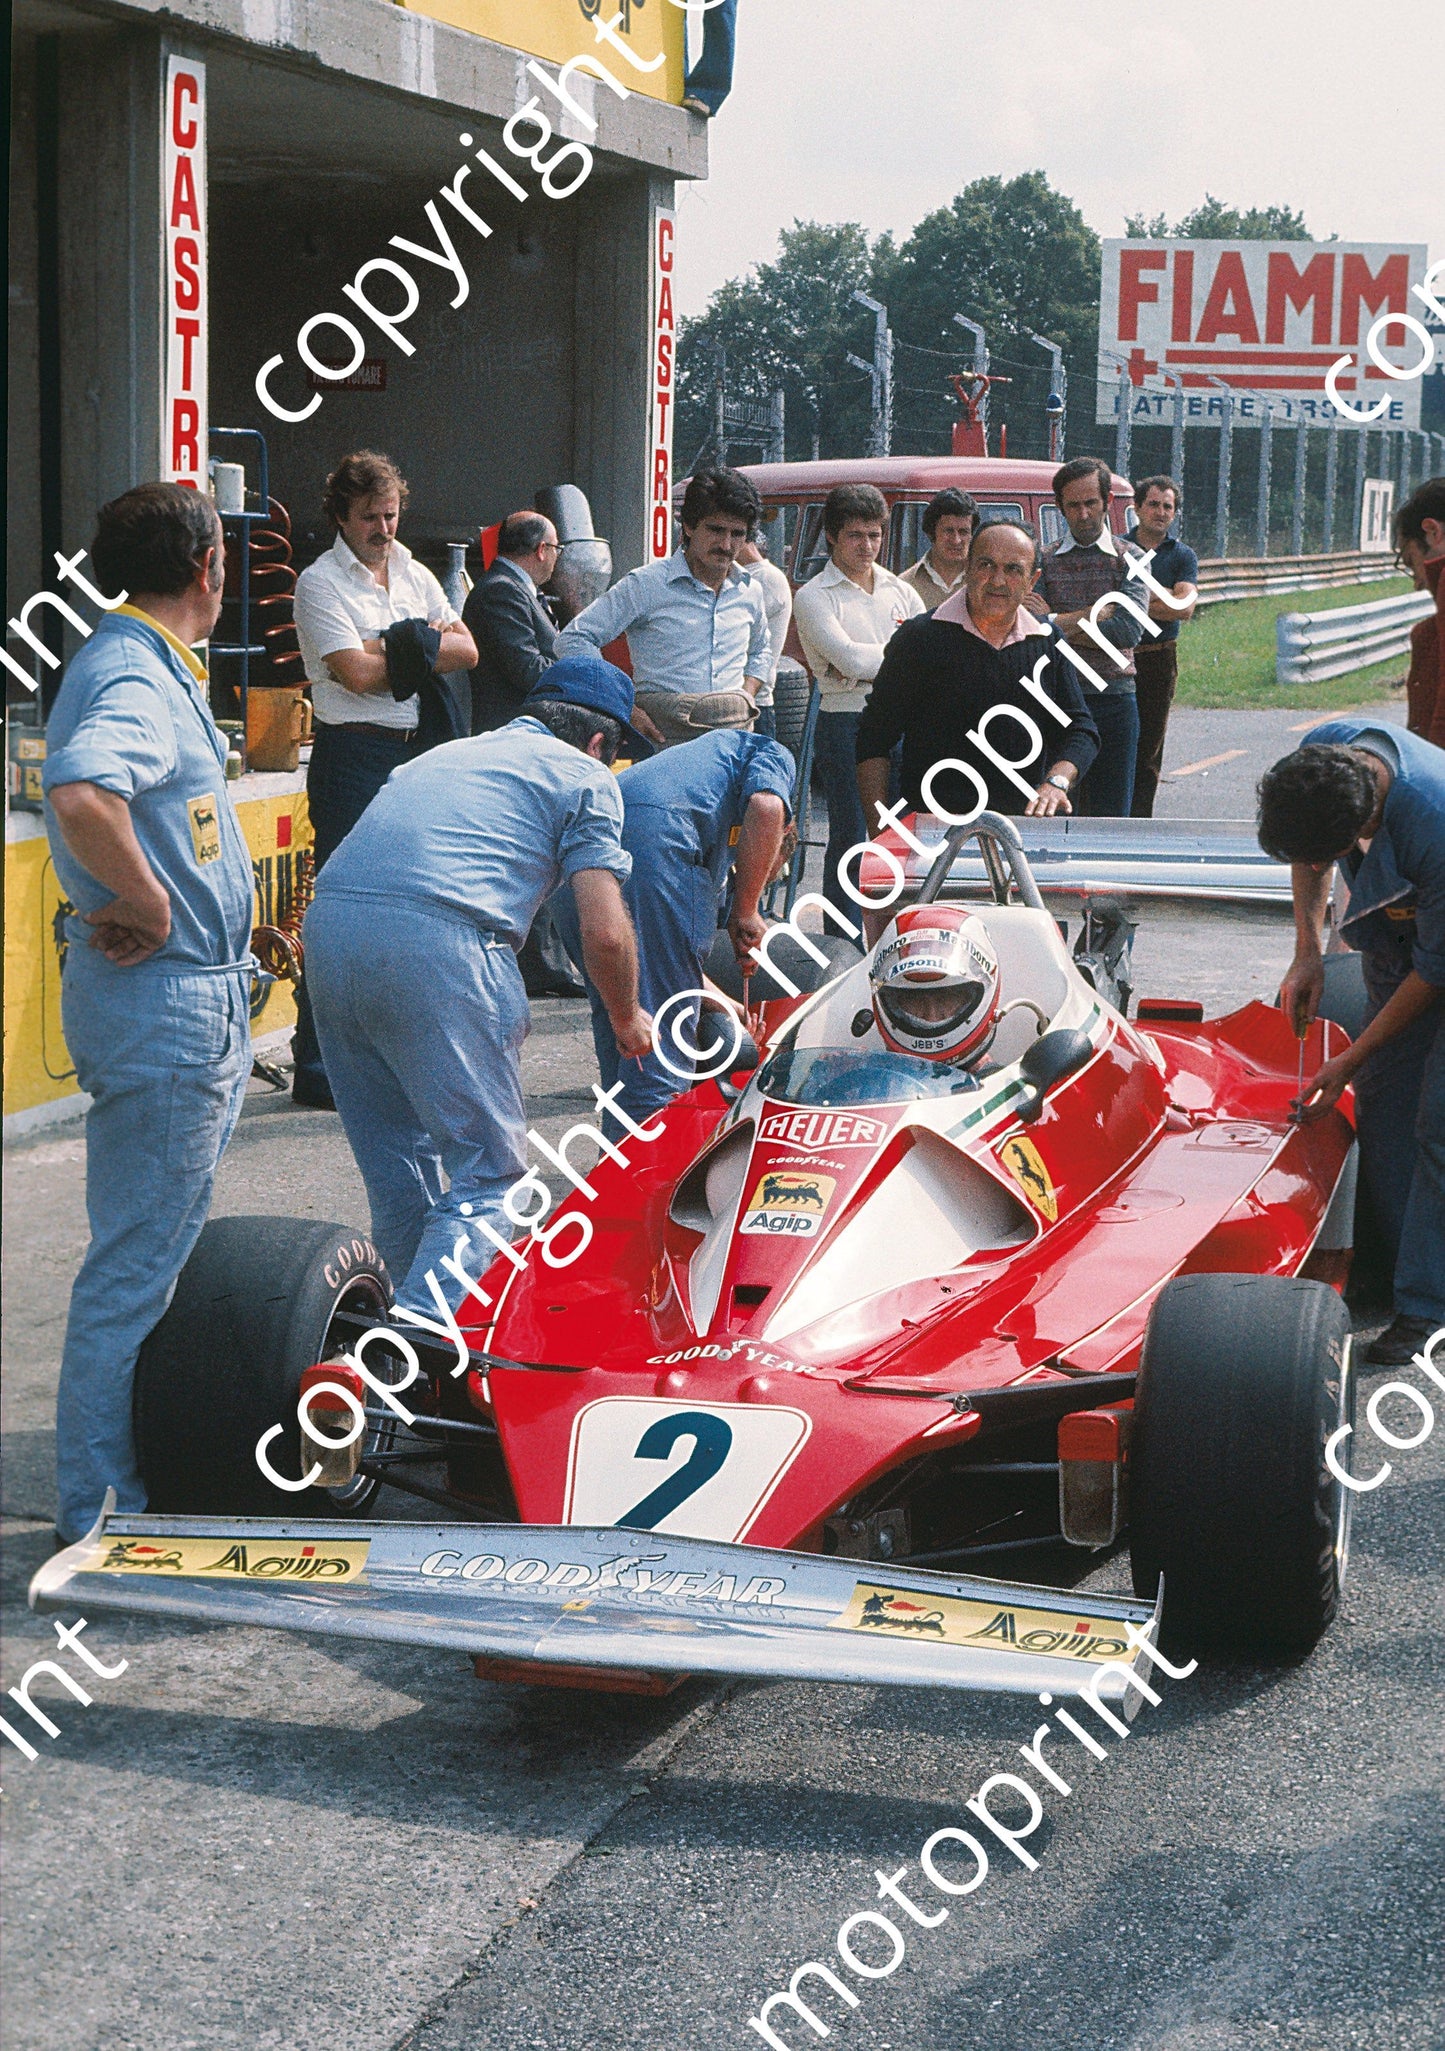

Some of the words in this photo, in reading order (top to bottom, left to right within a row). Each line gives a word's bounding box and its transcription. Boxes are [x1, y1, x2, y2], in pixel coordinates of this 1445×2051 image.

[1117, 248, 1410, 347] FIAMM
[653, 218, 674, 558] CASTRO
[889, 957, 948, 979] Ausoni
[938, 930, 992, 972] Malboro
[767, 1114, 876, 1147] HEUER
[747, 1212, 813, 1233] Agip
[613, 1411, 733, 1531] 2
[197, 1545, 351, 1579] Agip
[964, 1611, 1129, 1658] Agip
